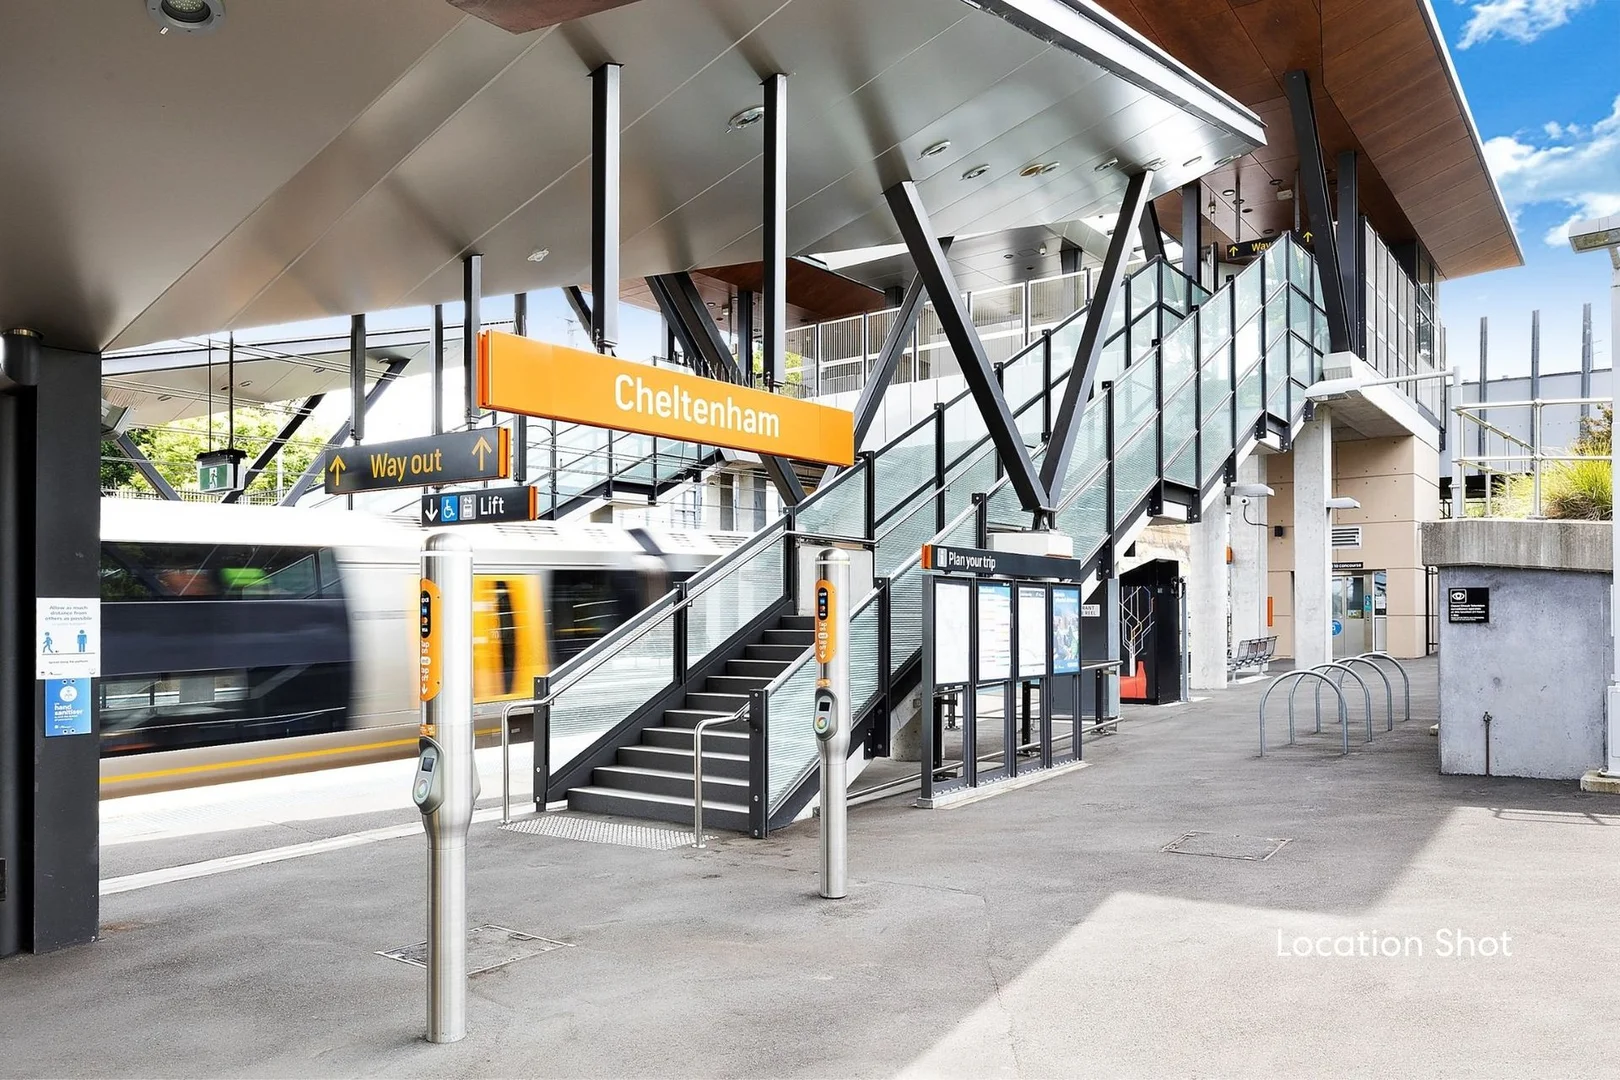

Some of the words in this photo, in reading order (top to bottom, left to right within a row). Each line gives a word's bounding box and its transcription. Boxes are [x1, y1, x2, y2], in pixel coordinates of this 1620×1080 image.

[614, 374, 780, 438] Cheltenham
[370, 452, 408, 482] Way
[411, 448, 442, 475] out
[480, 496, 504, 516] Lift
[948, 552, 966, 566] Plan
[966, 556, 983, 570] your
[983, 556, 996, 572] trip
